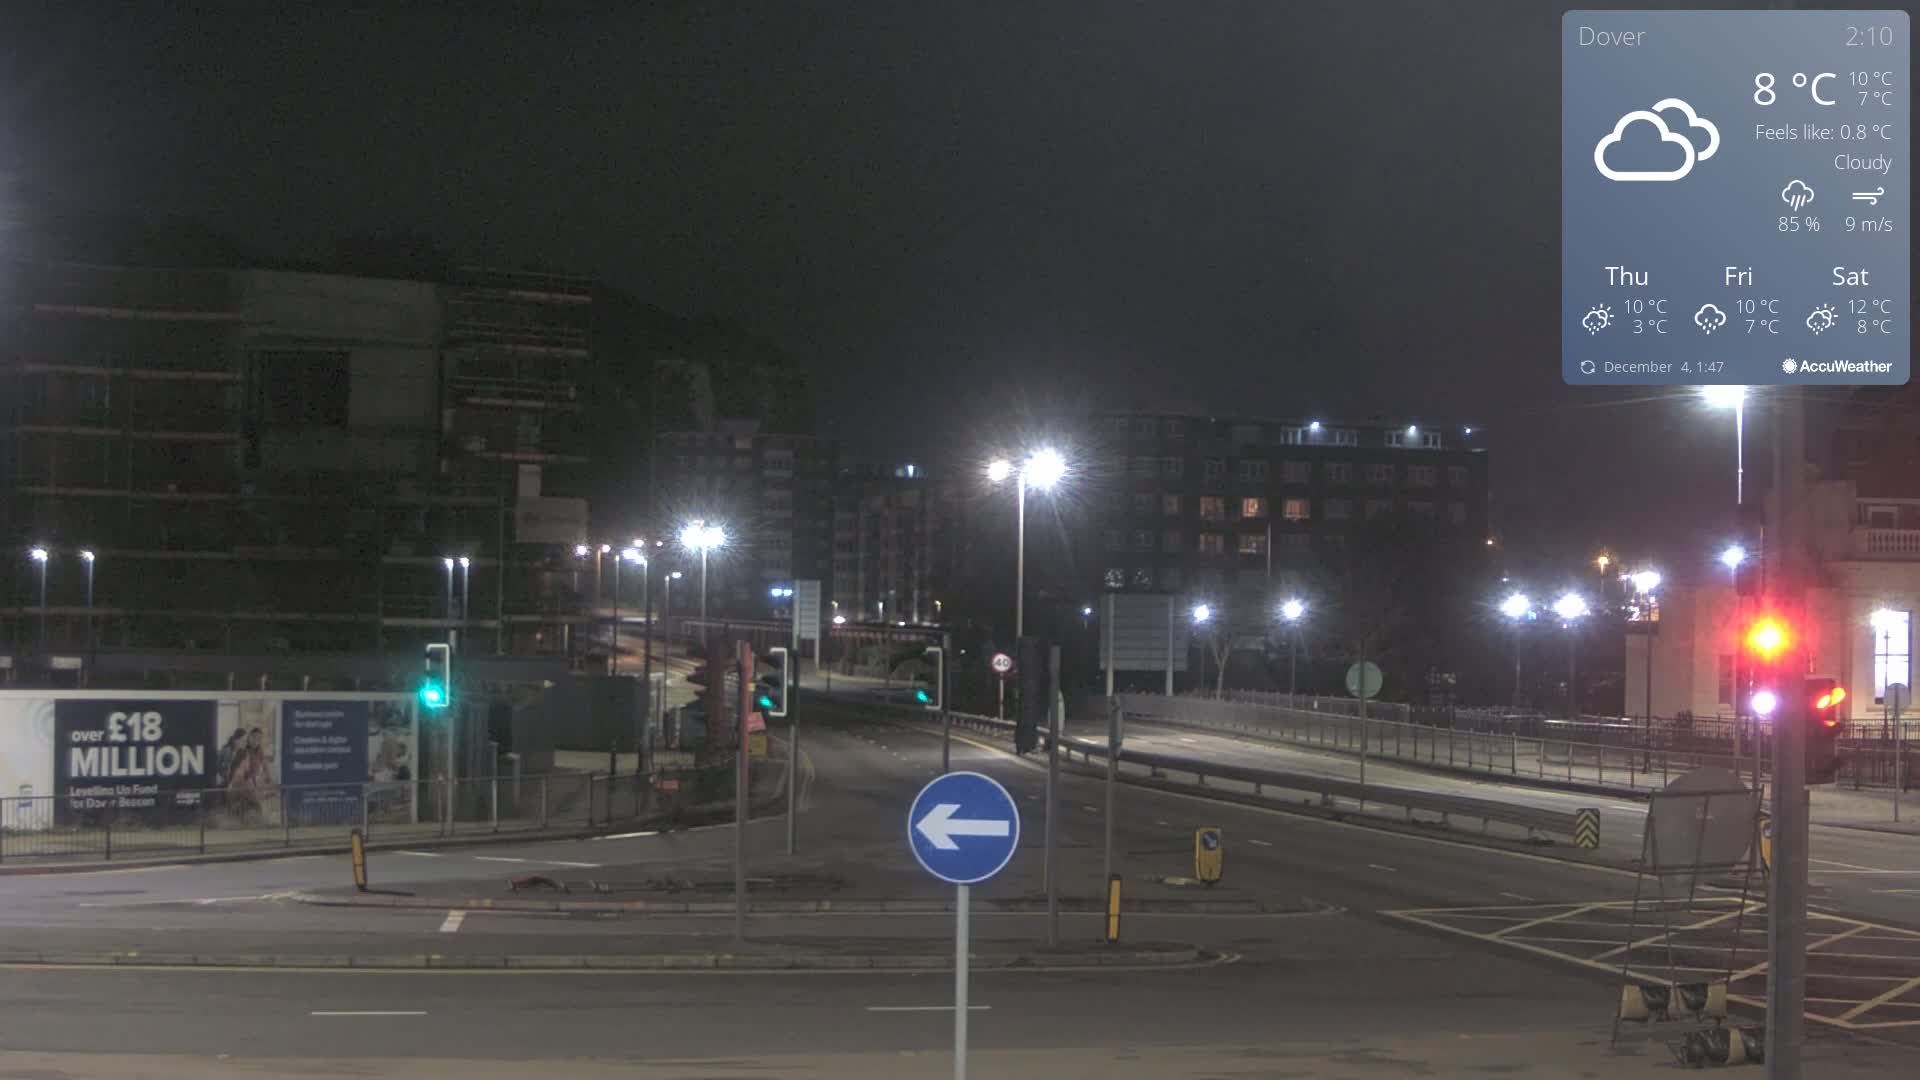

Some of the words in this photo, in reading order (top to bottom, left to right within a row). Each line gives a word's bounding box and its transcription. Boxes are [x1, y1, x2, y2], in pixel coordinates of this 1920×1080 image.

[71, 730, 104, 742] over
[108, 711, 162, 742] £18
[71, 745, 204, 777] MILLION
